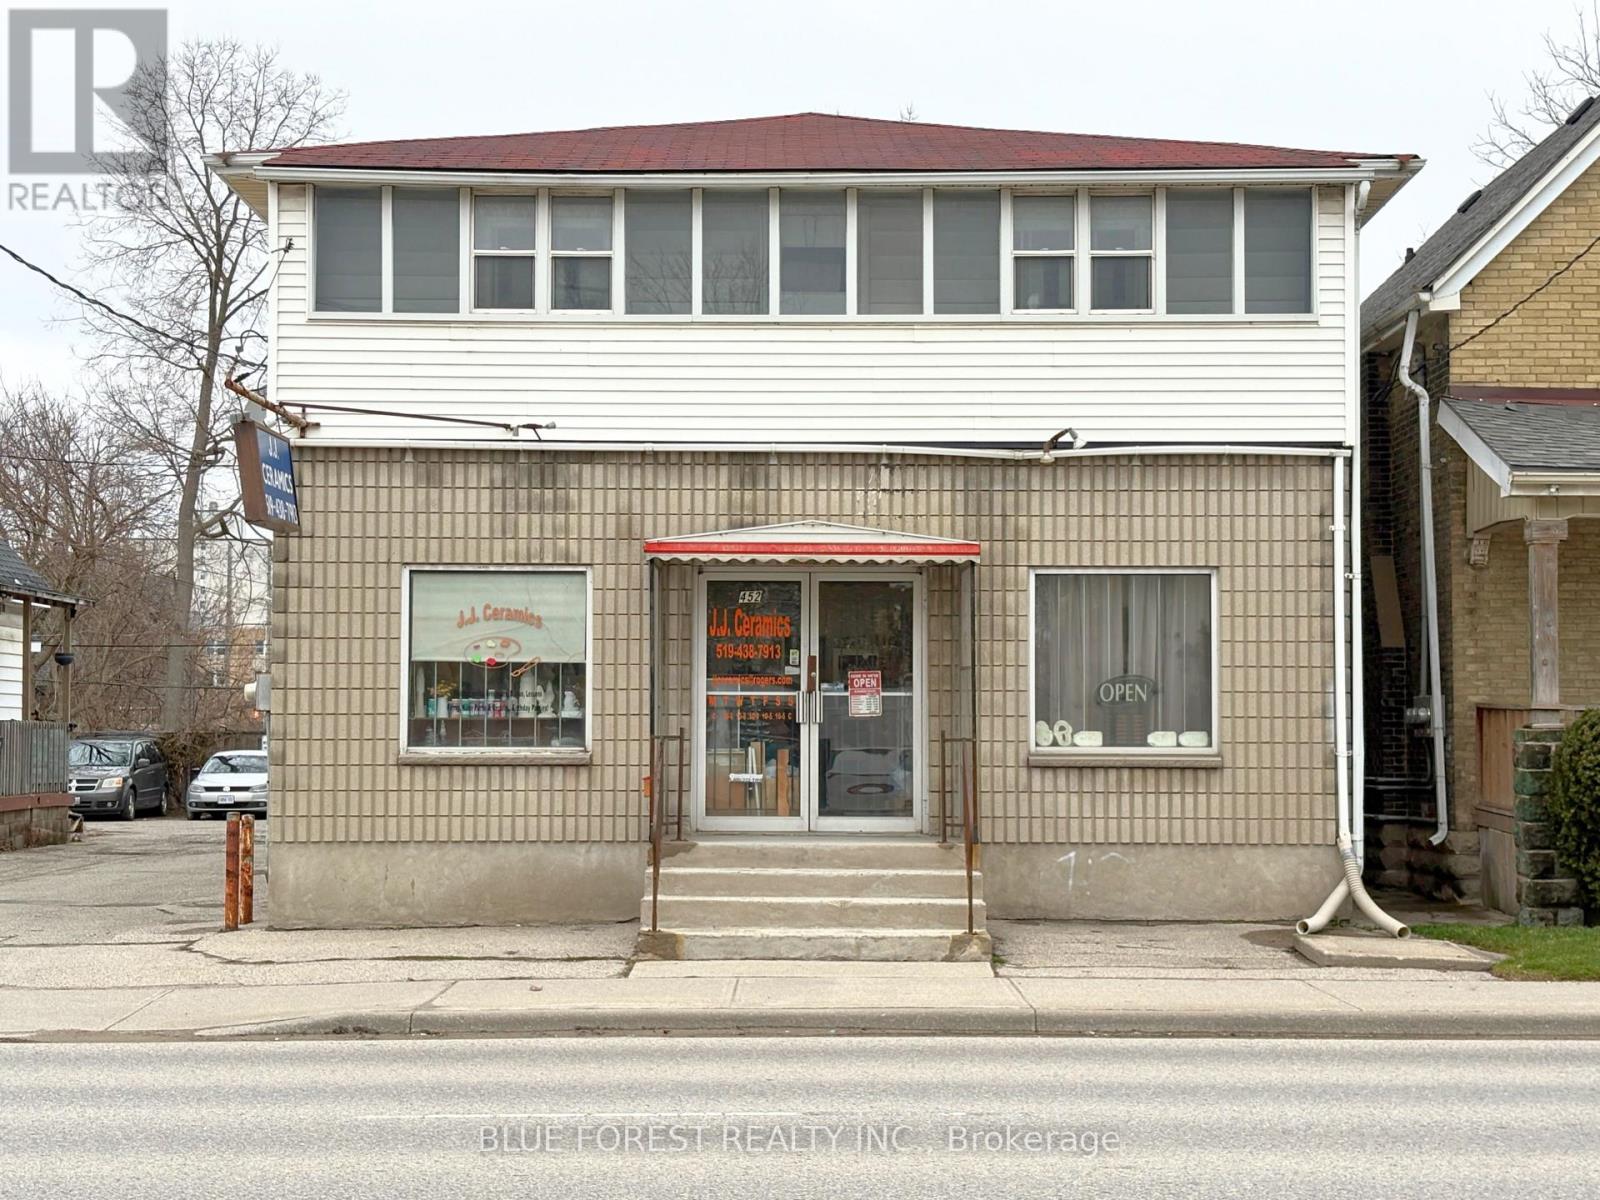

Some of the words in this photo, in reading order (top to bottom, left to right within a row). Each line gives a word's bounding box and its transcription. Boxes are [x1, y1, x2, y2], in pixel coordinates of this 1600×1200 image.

[483, 603, 543, 629] Ceramics
[709, 608, 731, 637] J.J.
[734, 607, 792, 638] Ceramics
[716, 643, 782, 660] 519-438-7913
[853, 678, 877, 688] OPEN
[1099, 683, 1147, 702] OPEN
